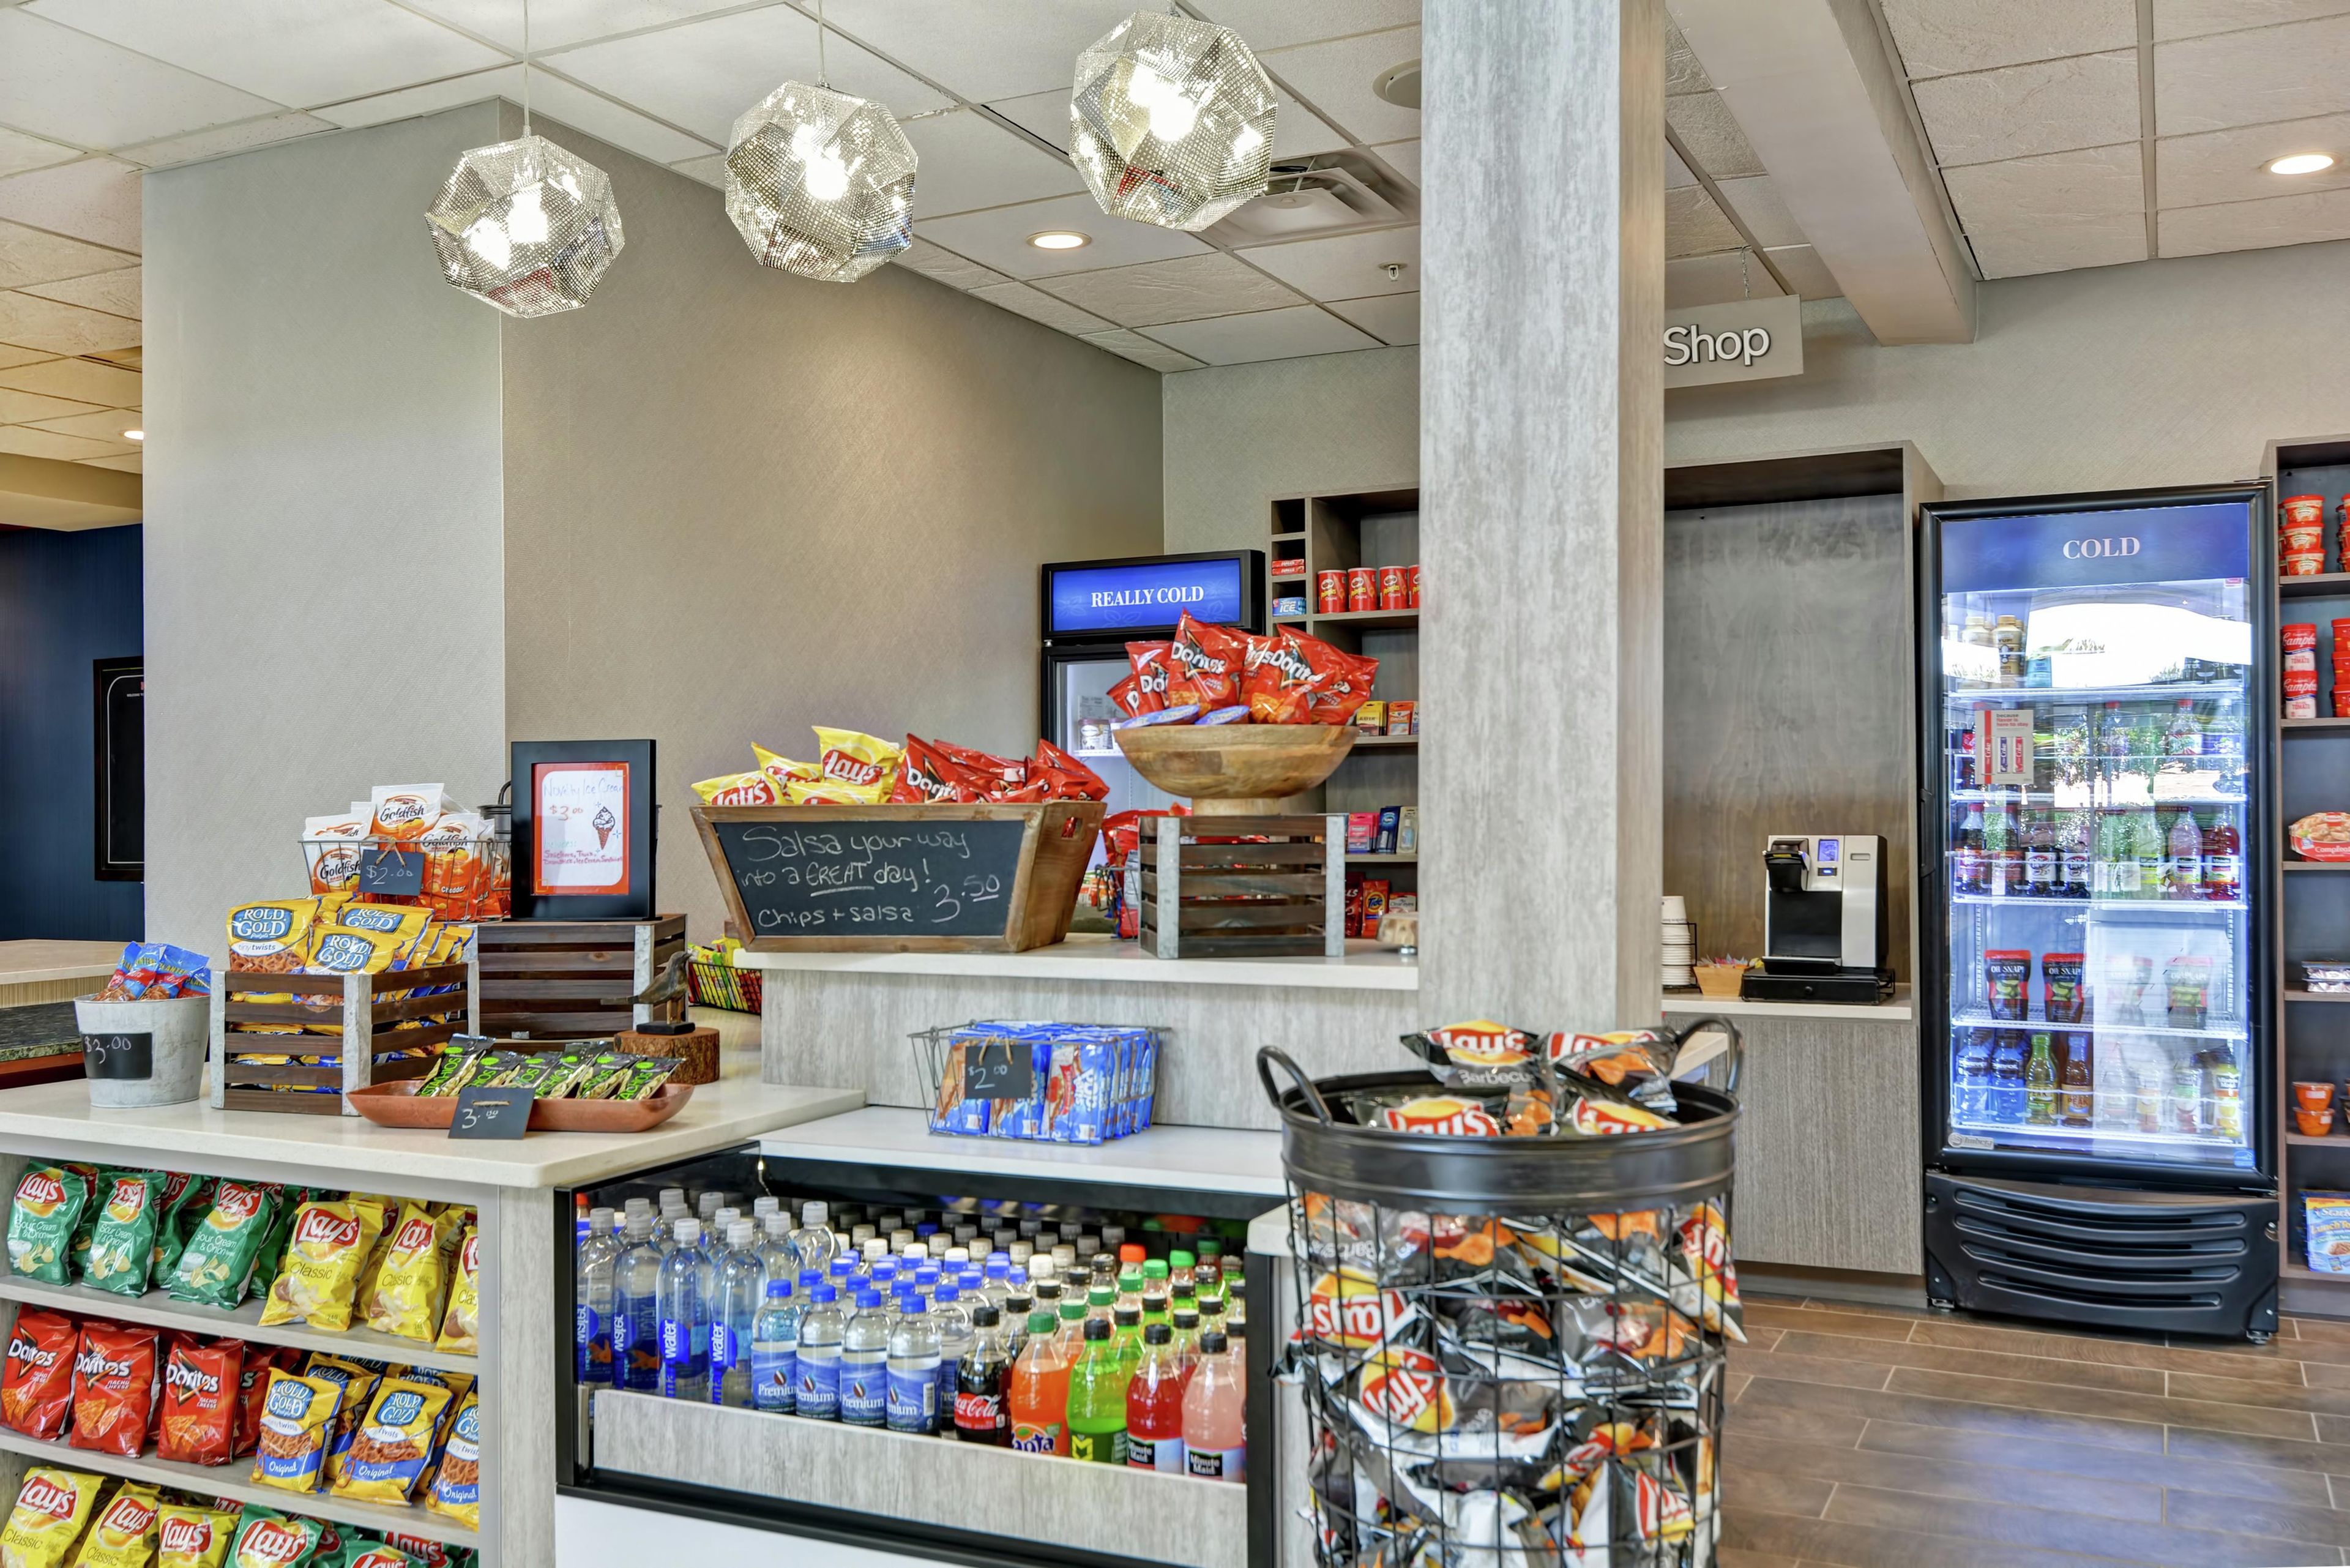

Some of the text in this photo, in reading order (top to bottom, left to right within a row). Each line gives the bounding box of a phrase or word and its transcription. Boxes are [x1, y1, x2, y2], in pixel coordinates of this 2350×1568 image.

[1663, 324, 1770, 366] Shop
[2063, 537, 2140, 559] COLD
[1091, 586, 1204, 607] REALLY COLD
[824, 752, 882, 785] Lay's
[379, 805, 425, 822] Goldfish
[422, 833, 469, 849] Goldfish
[742, 826, 970, 863] Salsa your way
[320, 860, 361, 881] Goldfish
[366, 865, 414, 885] $2.00
[736, 870, 775, 887] into
[781, 867, 801, 884] a
[758, 909, 825, 927] Chips
[851, 905, 914, 922] salsa
[931, 875, 1000, 923] 3.50
[1368, 897, 1383, 908] Tide
[244, 908, 284, 922] ROLD
[346, 916, 394, 931] GOLD
[237, 920, 286, 936] GOLD
[329, 935, 370, 951] ROLD
[318, 947, 364, 969] GOLD
[84, 1036, 132, 1064] $3.00
[968, 1064, 1007, 1090] $2.00
[17, 1173, 59, 1204] Lay's
[37, 1221, 57, 1231] Cream
[299, 1209, 358, 1246] Lay's
[195, 1232, 237, 1247] Sour Cream
[206, 1242, 226, 1255] Onion
[289, 1261, 332, 1280] Classic
[458, 1290, 478, 1305] Clas
[7, 1338, 57, 1367] Doritos
[166, 1364, 218, 1392] Doritos
[277, 1381, 309, 1400] ROLD
[392, 1393, 422, 1408] ROLD
[269, 1395, 304, 1417] GOLD
[380, 1407, 416, 1423] GOLD
[461, 1445, 479, 1456] twist
[1128, 1443, 1152, 1455] Minute
[269, 1461, 297, 1476] Original
[1190, 1455, 1220, 1467] Minute
[1193, 1465, 1216, 1475] Maid
[359, 1465, 394, 1479] Original
[16, 1477, 75, 1515] Lay's
[443, 1487, 477, 1503] Original
[102, 1499, 155, 1535] Lay's
[4, 1529, 42, 1550] Classic
[163, 1519, 211, 1557] Lay's
[246, 1521, 306, 1564] Lay's
[86, 1546, 119, 1567] Classic
